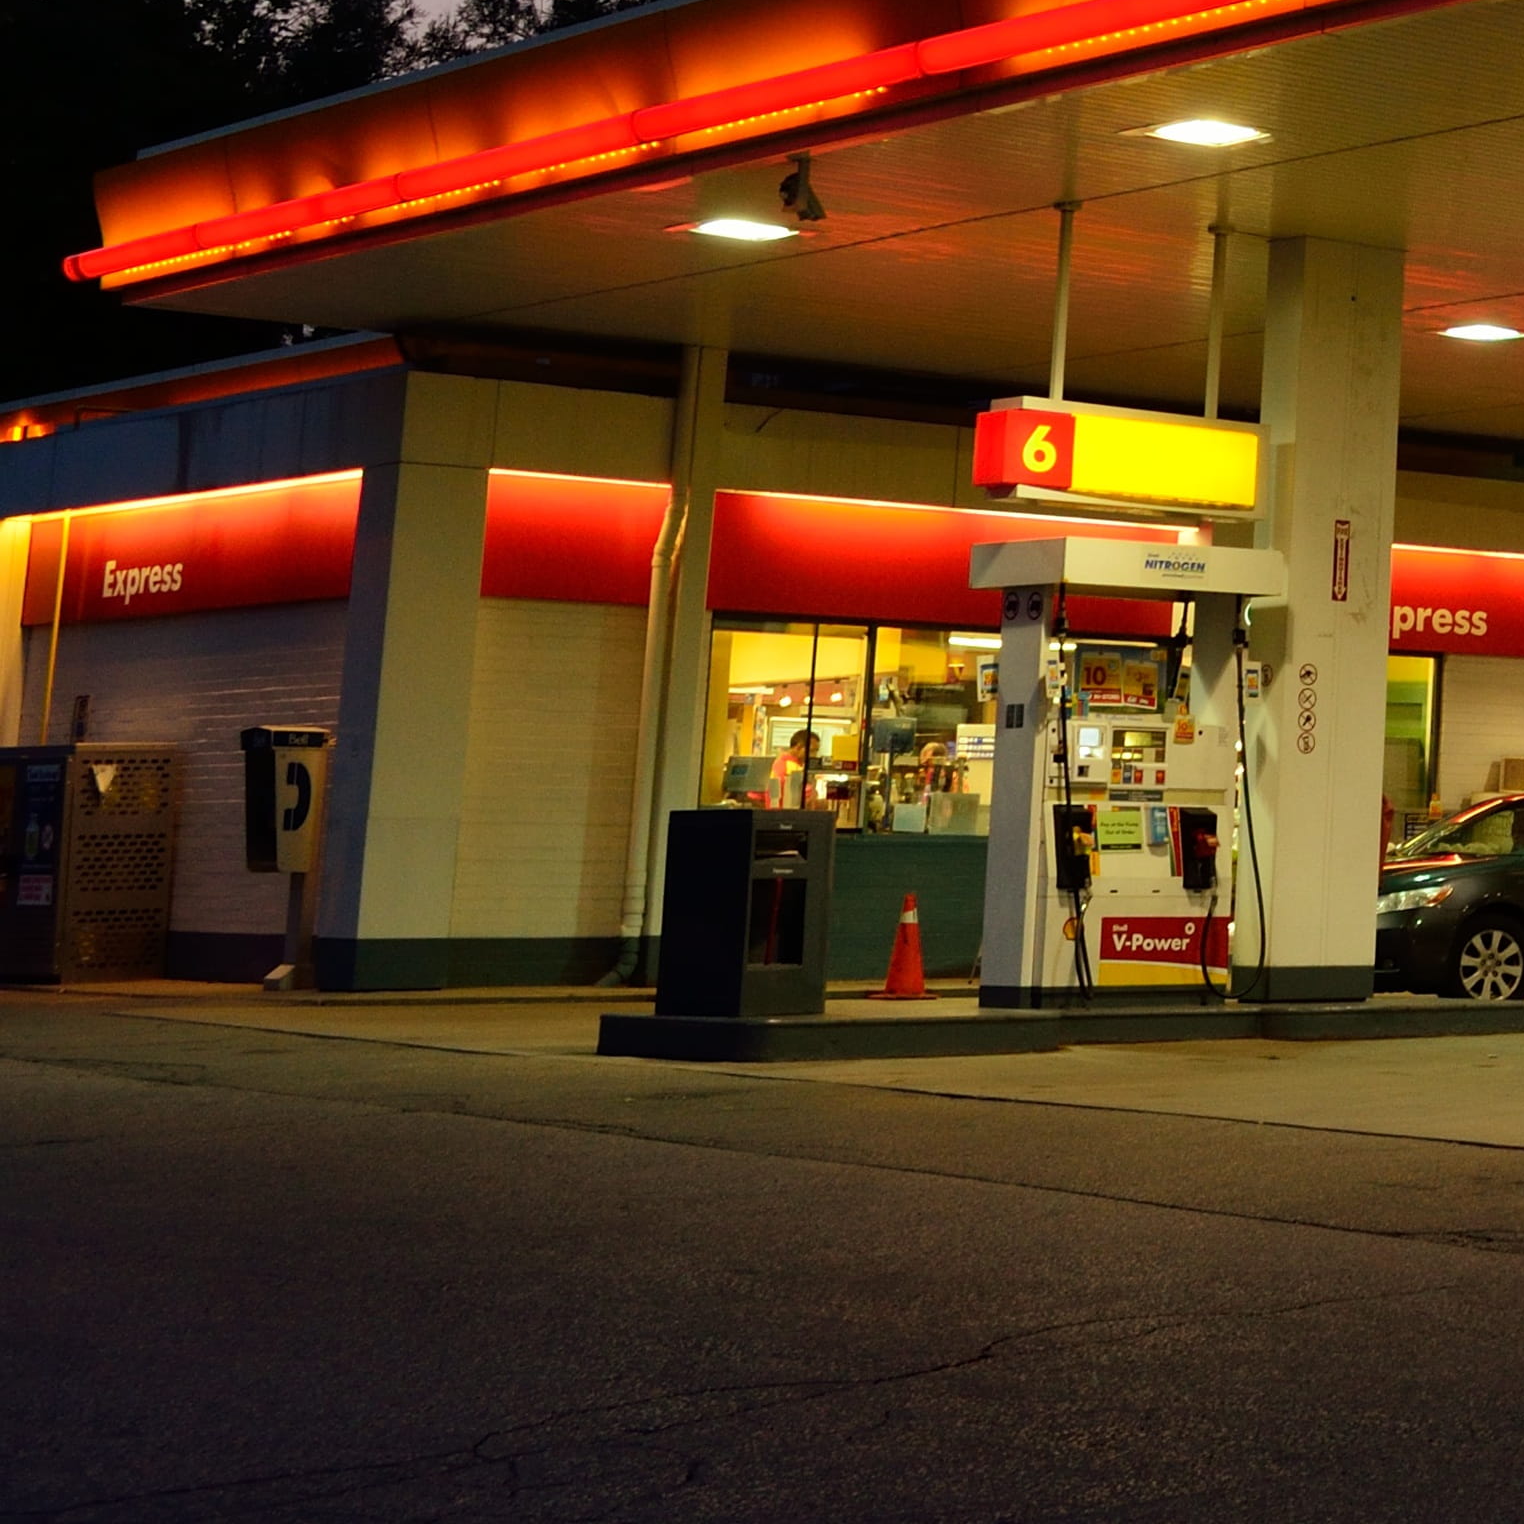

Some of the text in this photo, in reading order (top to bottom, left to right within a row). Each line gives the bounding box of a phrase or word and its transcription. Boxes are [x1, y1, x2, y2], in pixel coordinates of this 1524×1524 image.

[1022, 425, 1057, 472] 6
[102, 559, 184, 605] Express
[1144, 558, 1206, 573] NITROGEN
[1392, 605, 1488, 639] press
[1112, 933, 1190, 952] V-Power
